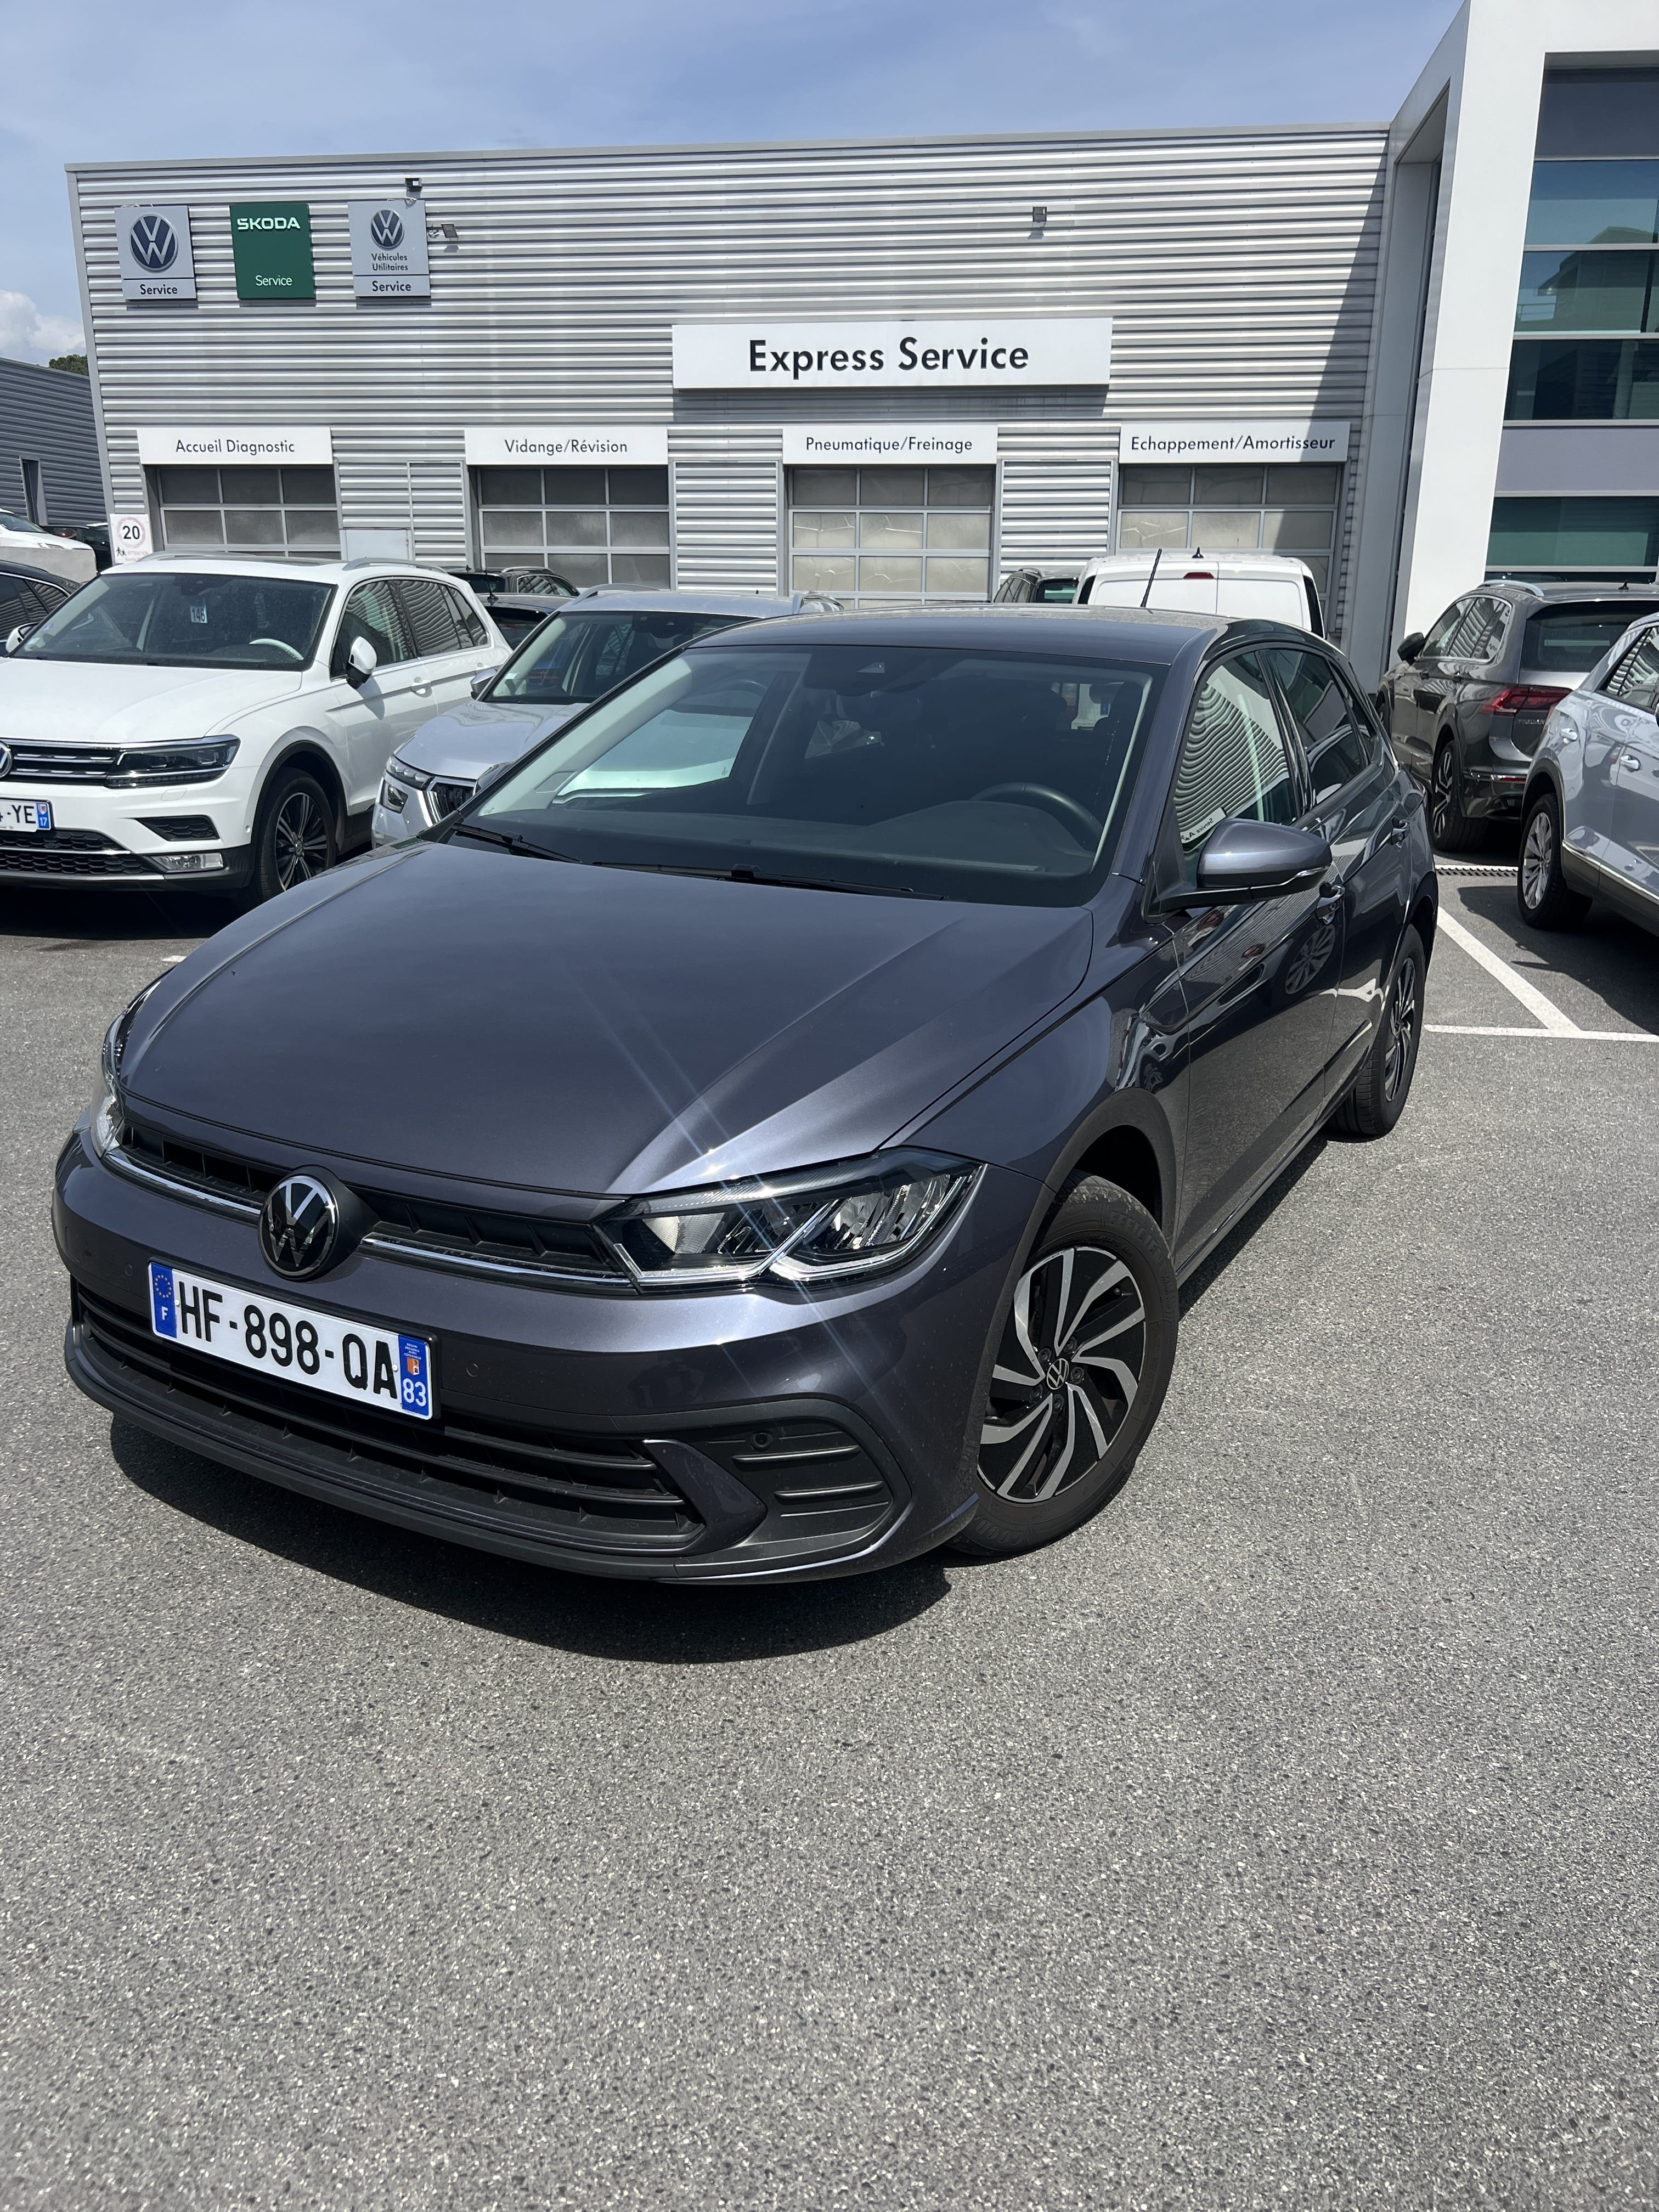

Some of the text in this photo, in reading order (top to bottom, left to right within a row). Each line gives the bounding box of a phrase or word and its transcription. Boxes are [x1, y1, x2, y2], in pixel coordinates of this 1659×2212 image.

[237, 217, 301, 230] SKODA
[371, 252, 408, 261] Véhicules
[372, 263, 408, 271] Utilitaires
[255, 275, 292, 286] Service
[372, 280, 411, 292] Service
[139, 284, 178, 295] Service
[749, 337, 1029, 380] Express Service
[176, 438, 295, 456] Accueil Diagnostic
[504, 438, 628, 456] Vidange/Révision
[806, 436, 973, 455] Pneumatique/Freinage
[1131, 433, 1336, 454] Echappement/Amortisseur
[122, 525, 140, 540] 20
[191, 607, 205, 622] 146
[39, 817, 48, 826] 17
[161, 1306, 168, 1321] F
[179, 1280, 398, 1400] HF-898-QA
[403, 1378, 427, 1407] 83
